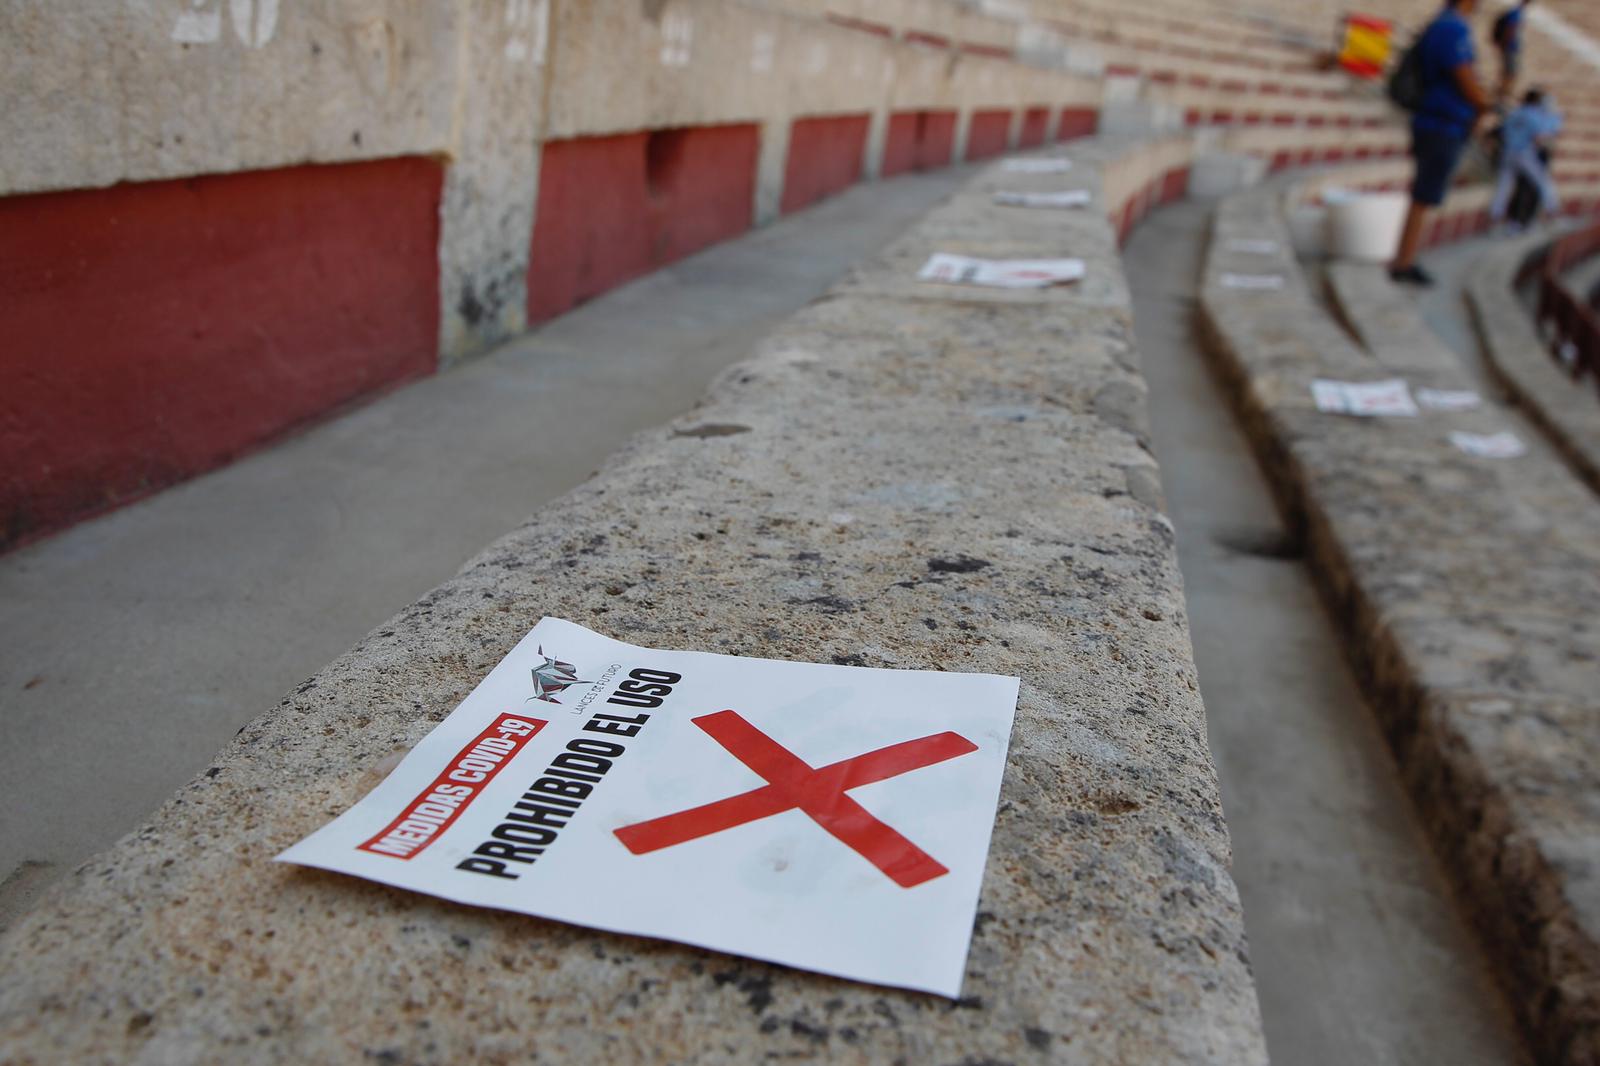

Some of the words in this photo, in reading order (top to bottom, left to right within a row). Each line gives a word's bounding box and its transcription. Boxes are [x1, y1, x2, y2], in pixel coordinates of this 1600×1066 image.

[570, 692, 598, 715] LANCES
[596, 663, 622, 686] FUTURO
[606, 667, 682, 708] USO
[582, 713, 651, 738] EL
[368, 783, 475, 857] MEDIDAS
[448, 718, 536, 783] COVID-19
[454, 738, 626, 880] PROHIBIDO
